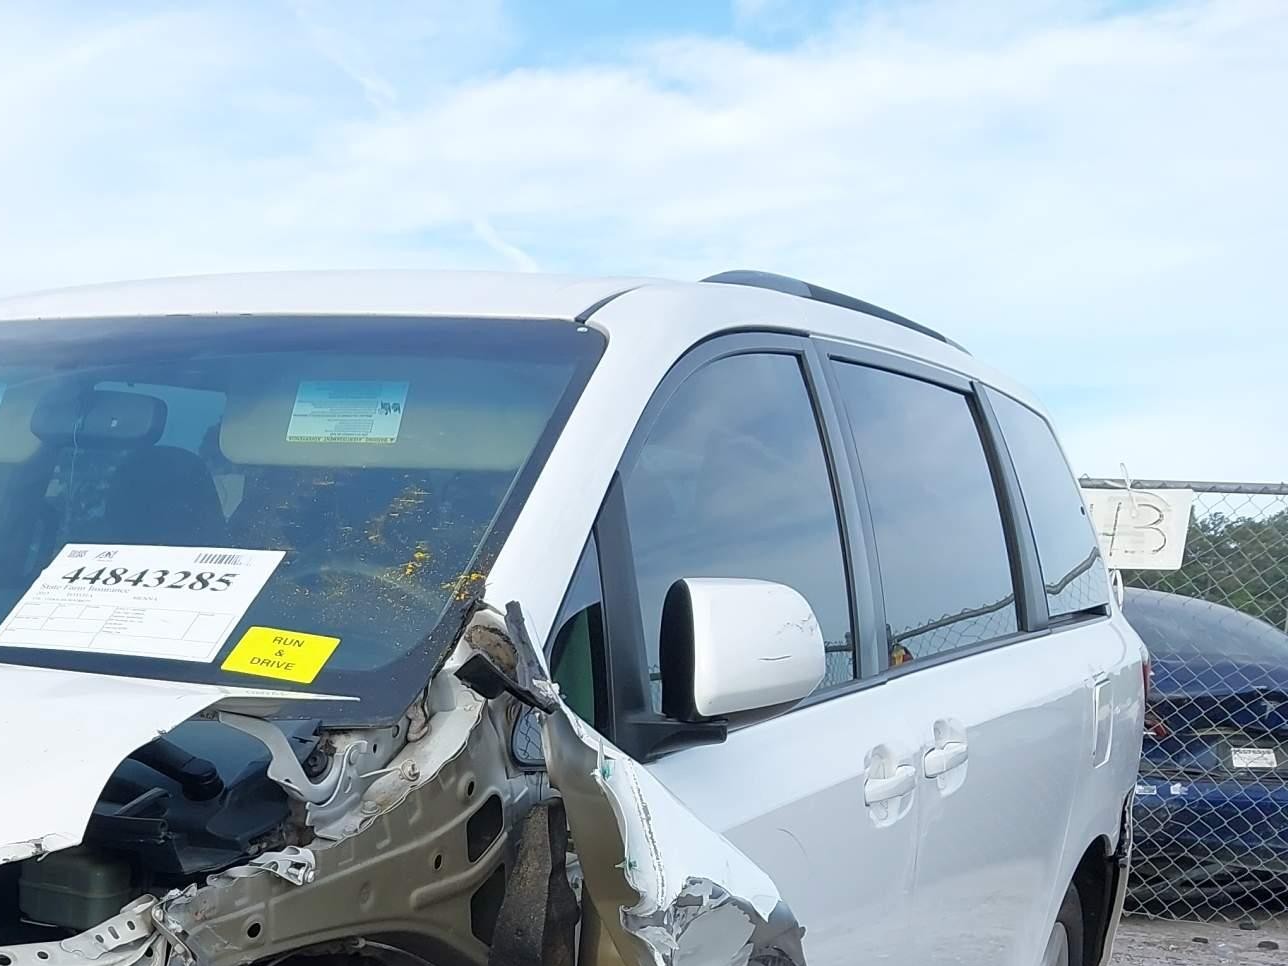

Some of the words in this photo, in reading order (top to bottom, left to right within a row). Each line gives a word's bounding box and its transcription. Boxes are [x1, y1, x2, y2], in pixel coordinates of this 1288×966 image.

[62, 566, 239, 592] 44843285
[272, 636, 305, 648] RUN
[274, 649, 286, 658] &
[250, 656, 296, 671] DRIVE
